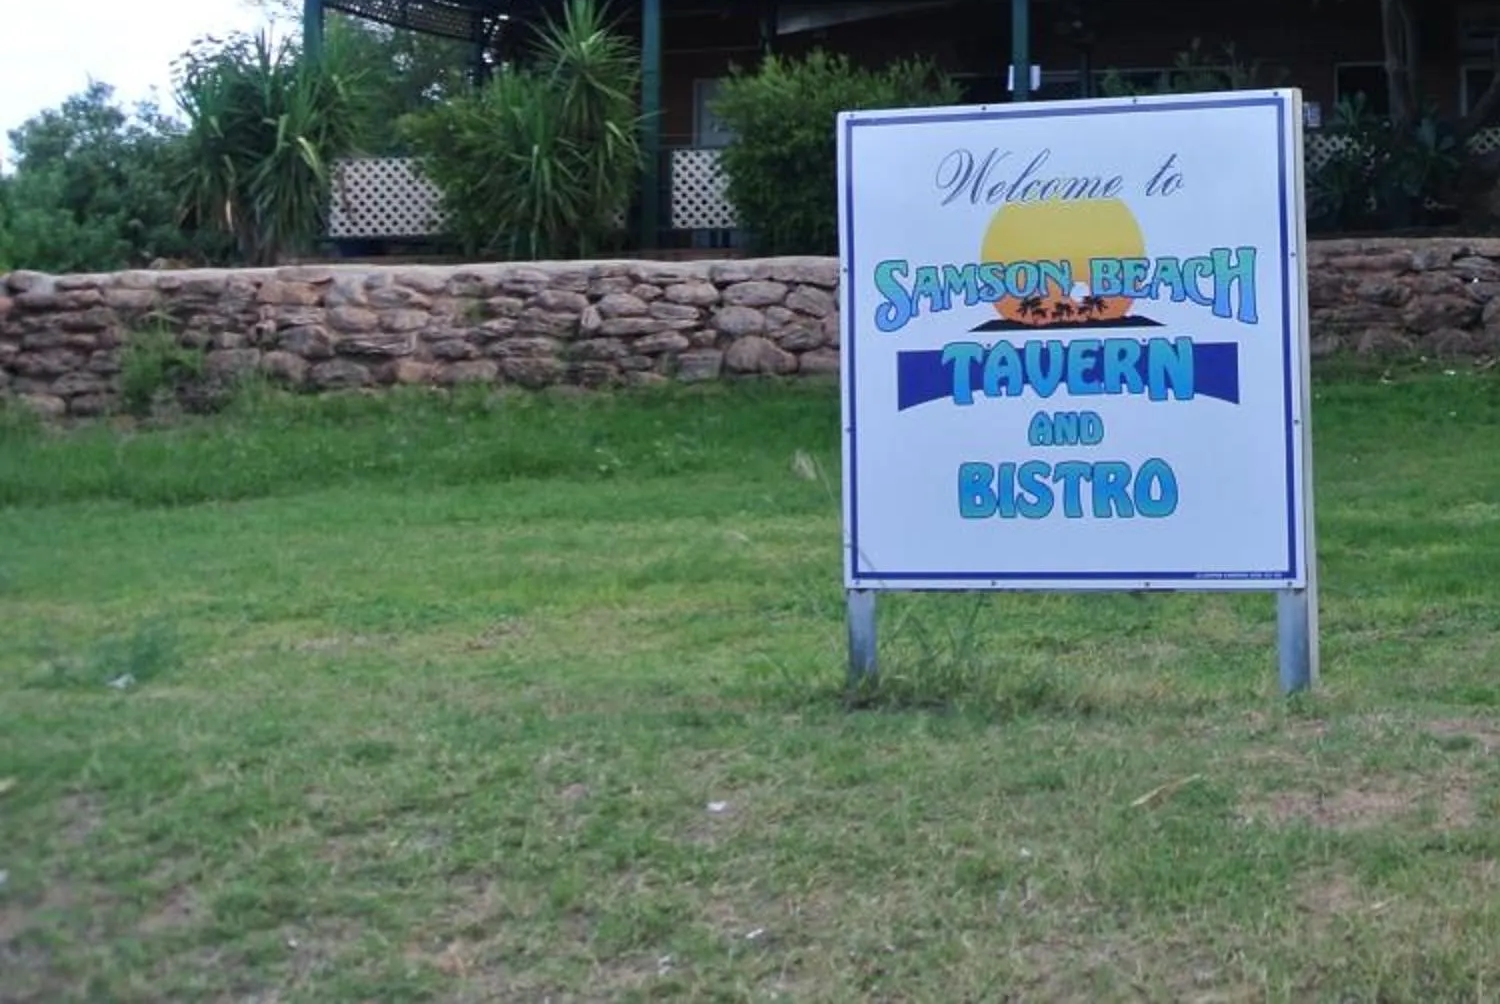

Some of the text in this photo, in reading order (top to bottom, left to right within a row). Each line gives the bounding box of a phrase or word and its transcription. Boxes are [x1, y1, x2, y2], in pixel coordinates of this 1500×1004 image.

[935, 147, 1184, 207] Welcome to
[874, 246, 1259, 332] SAMSON BEACH
[942, 336, 1195, 406] TAVERN
[1028, 412, 1104, 446] AND
[958, 458, 1179, 519] BISTRO
